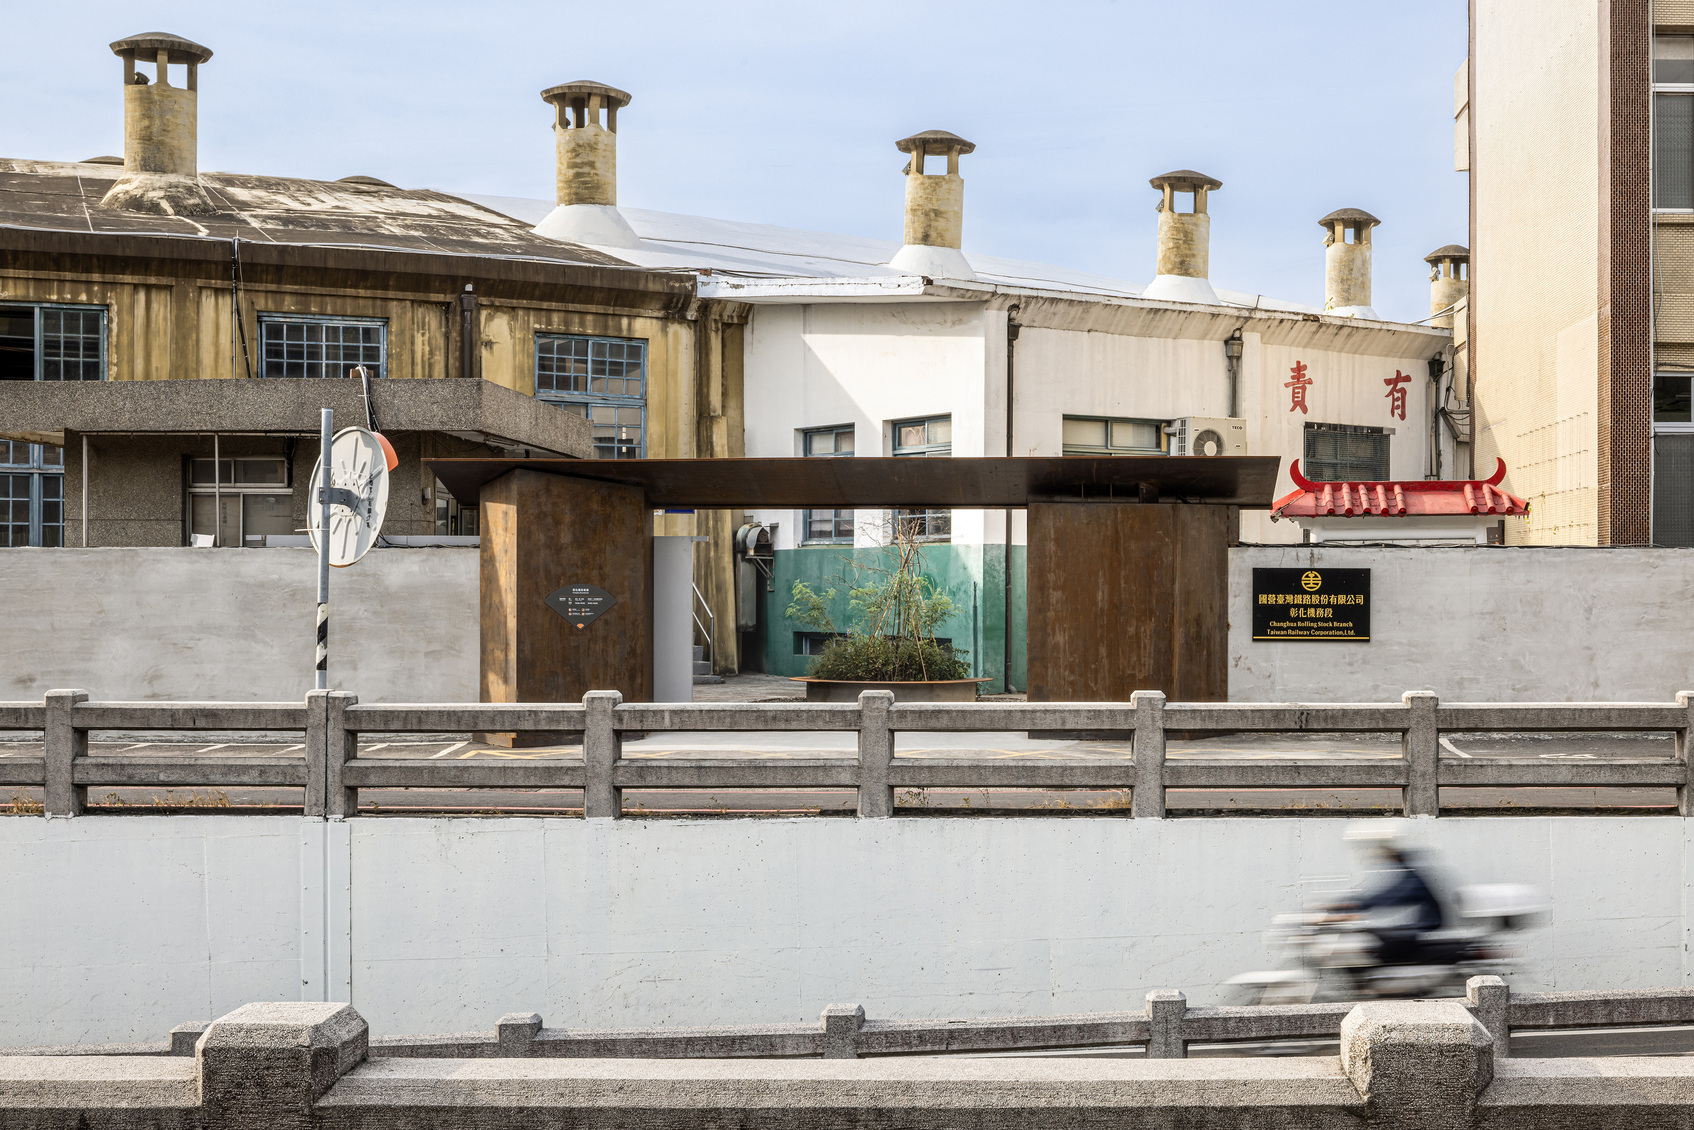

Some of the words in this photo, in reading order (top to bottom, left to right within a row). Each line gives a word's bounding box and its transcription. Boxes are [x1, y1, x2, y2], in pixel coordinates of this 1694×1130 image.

[1284, 360, 1314, 414] 責
[1383, 369, 1412, 421] 有
[1258, 594, 1364, 605] 國營臺灣鐵路股份有限公司
[1290, 608, 1333, 618] 彰化機務段
